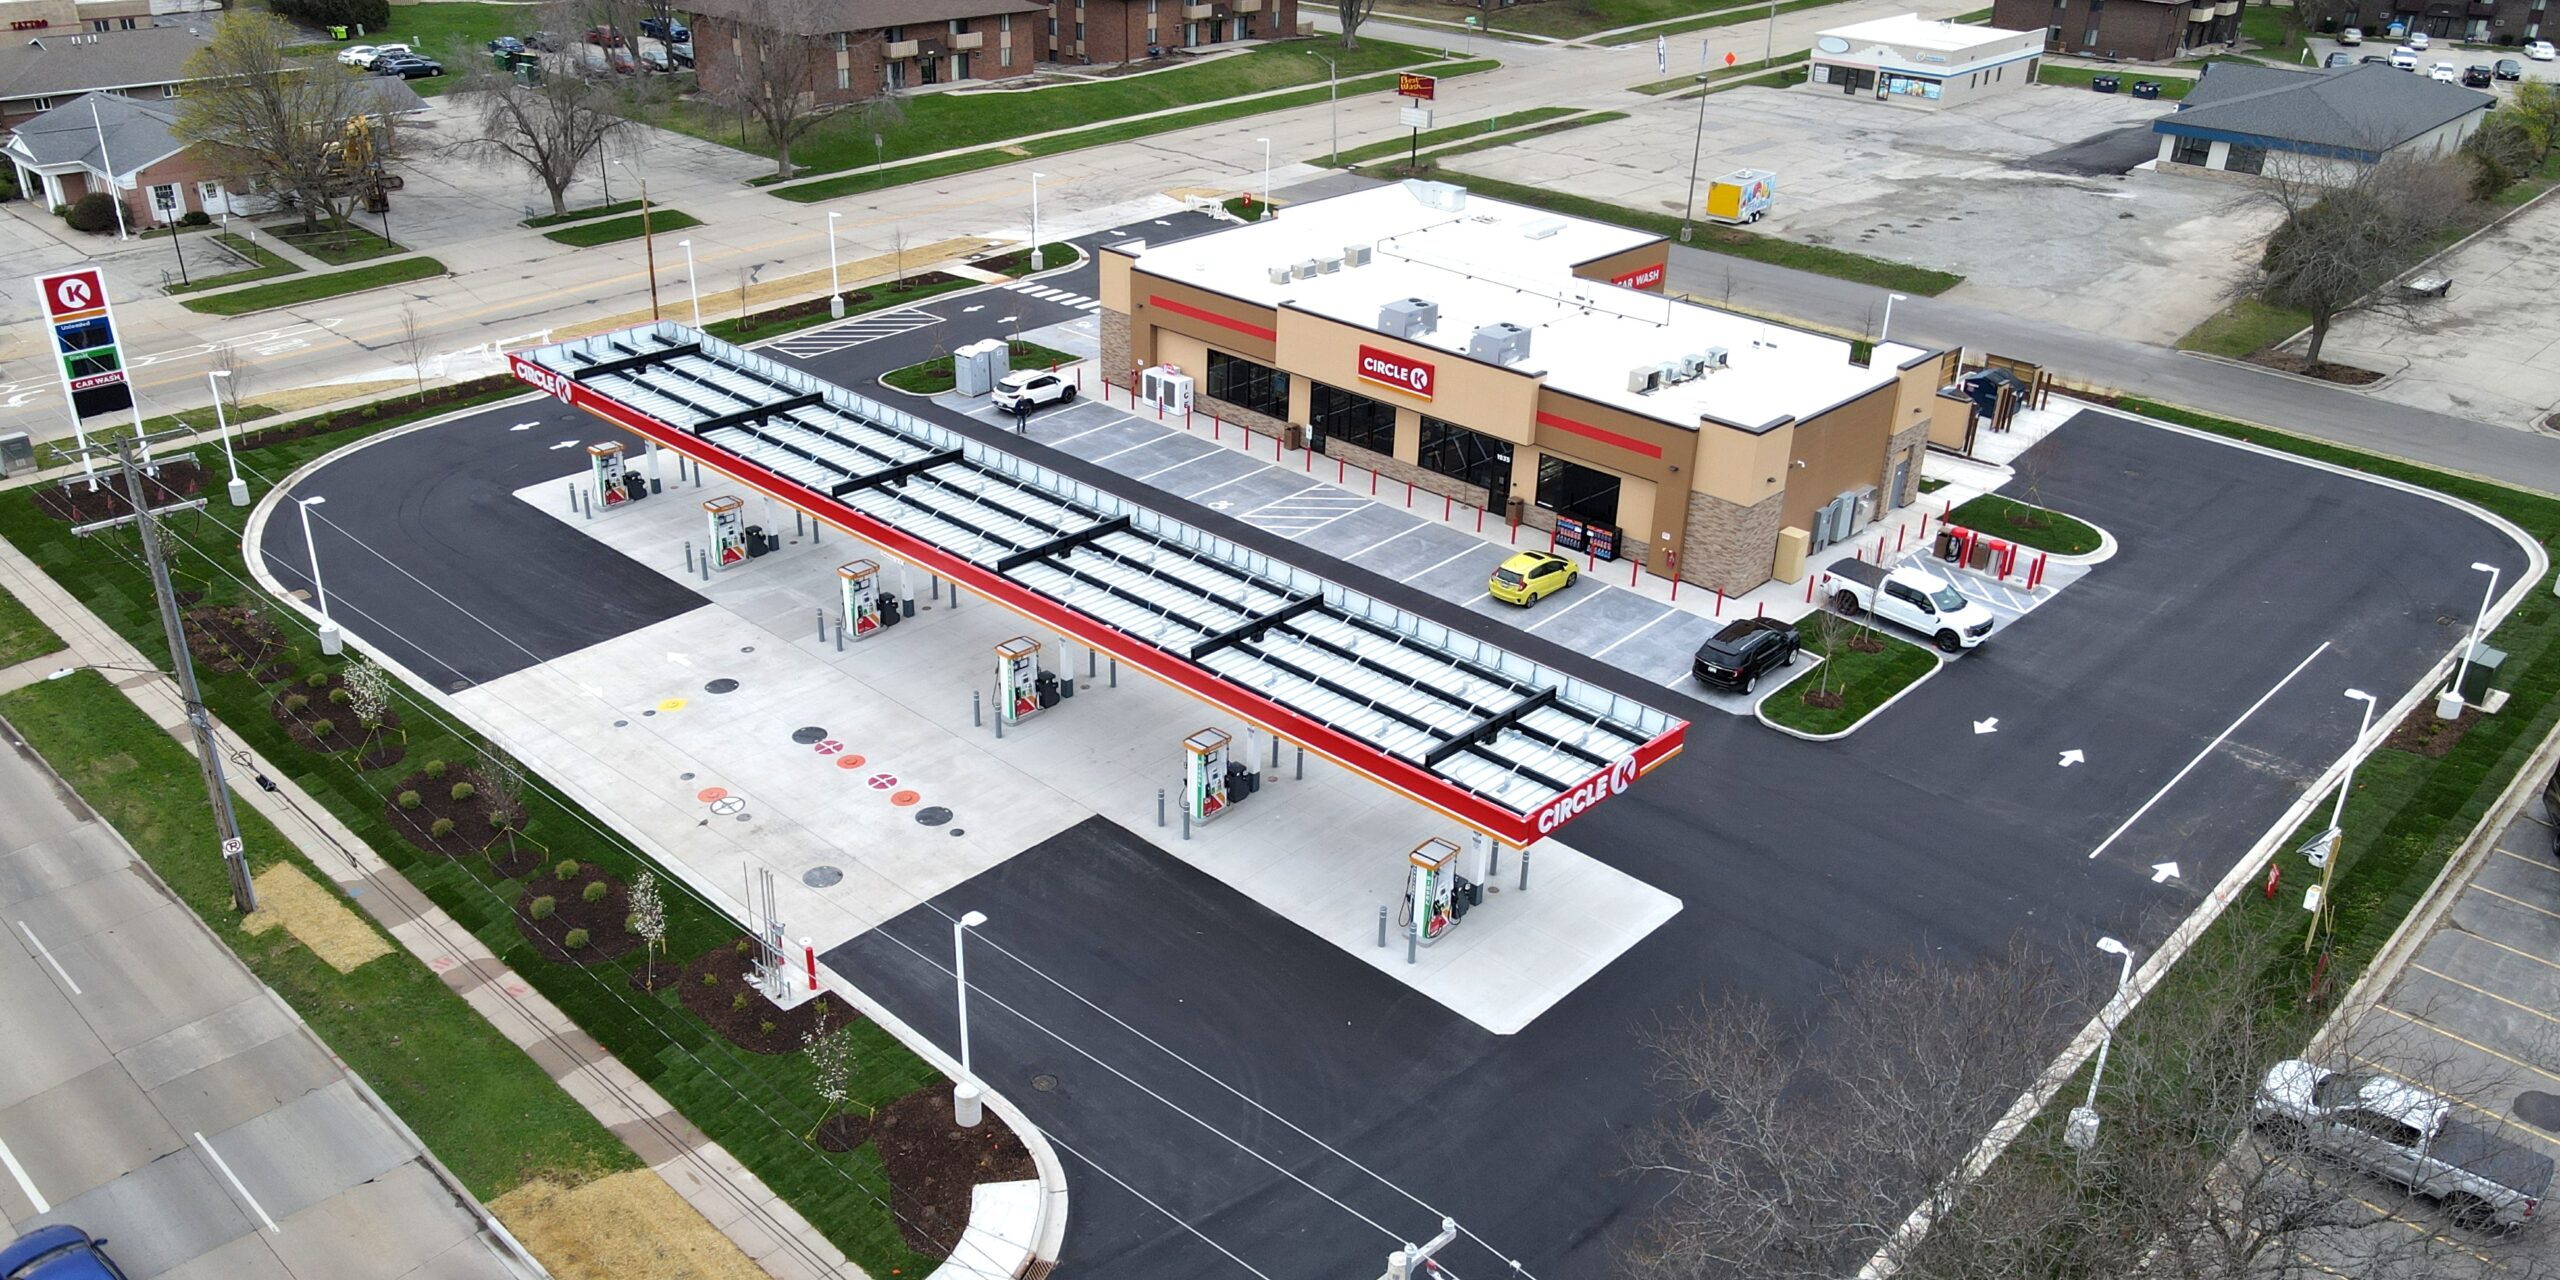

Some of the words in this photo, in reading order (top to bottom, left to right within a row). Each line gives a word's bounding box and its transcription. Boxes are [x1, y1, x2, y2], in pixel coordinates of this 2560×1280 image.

[1635, 269, 1660, 286] WASH
[62, 281, 91, 305] K
[75, 380, 94, 389] CAR
[95, 374, 121, 385] WASH
[516, 362, 556, 393] CIRCLE
[557, 377, 571, 403] K
[1364, 357, 1408, 380] CIRCLE
[1412, 369, 1427, 389] K
[1538, 775, 1609, 833] CIRCLE
[1613, 757, 1635, 792] K
